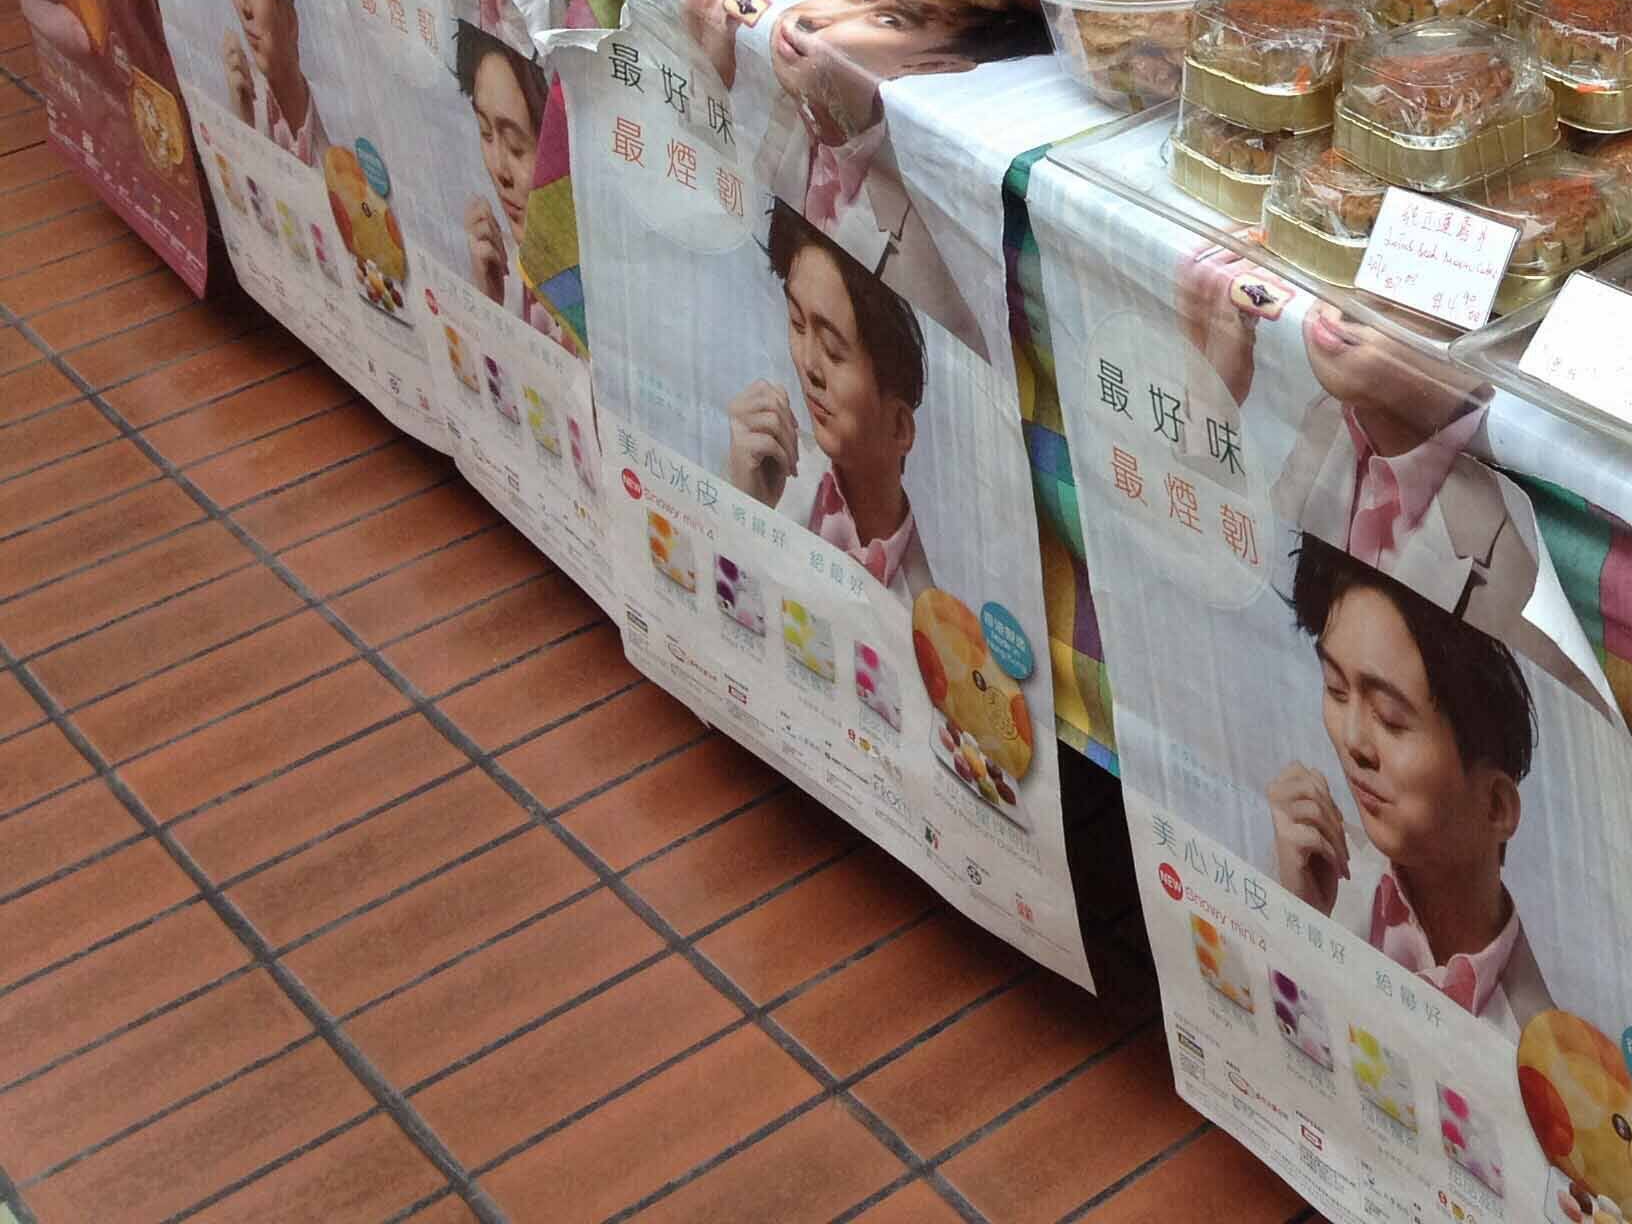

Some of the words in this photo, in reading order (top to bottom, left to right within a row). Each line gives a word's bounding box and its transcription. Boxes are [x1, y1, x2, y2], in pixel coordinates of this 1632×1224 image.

[608, 43, 736, 145] 最好味
[1097, 358, 1245, 476] 最好味
[1112, 445, 1259, 565] 最煙韌
